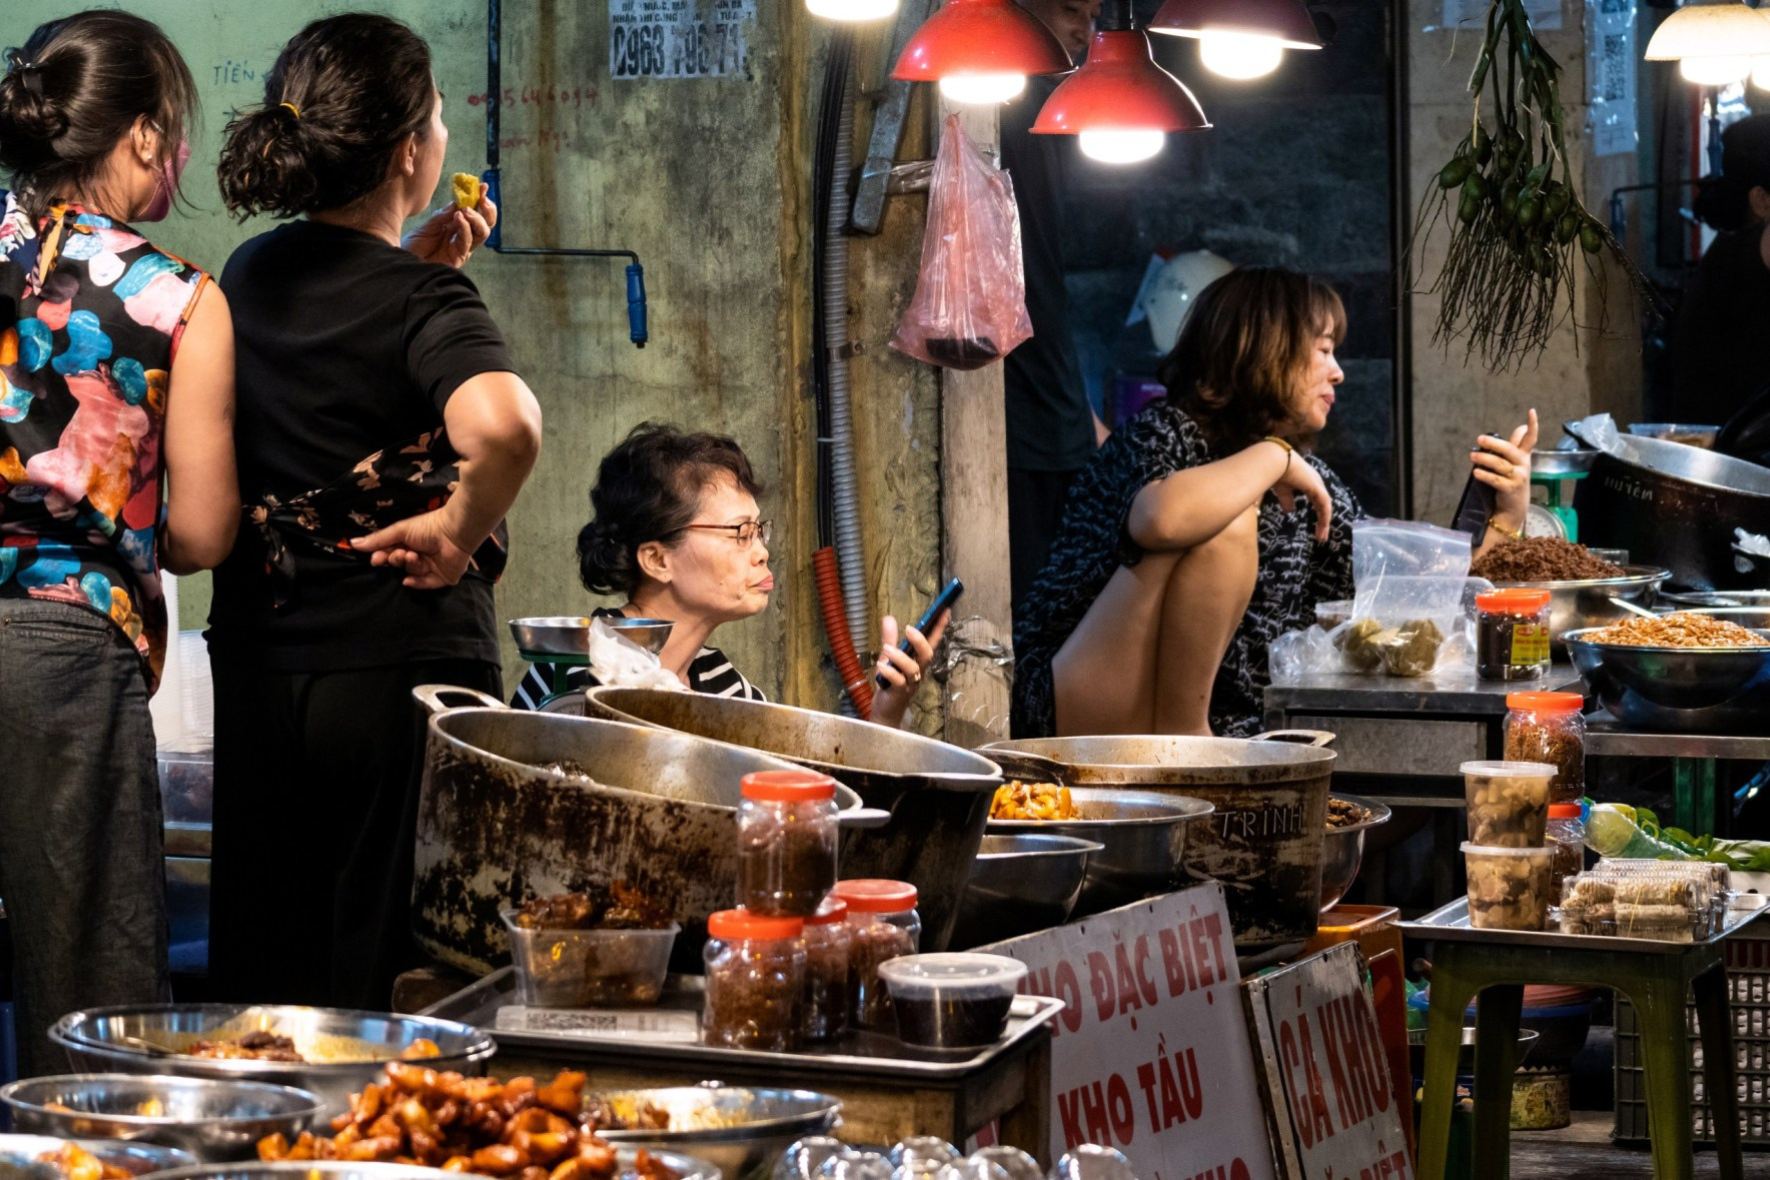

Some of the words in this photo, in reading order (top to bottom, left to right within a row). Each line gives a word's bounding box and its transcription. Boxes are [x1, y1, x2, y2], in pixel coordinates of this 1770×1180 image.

[1087, 930, 1158, 1031] ĐẶC
[1158, 905, 1227, 1005] BIỆT
[1057, 1073, 1134, 1150] KHO
[1137, 1033, 1204, 1133] TẦU
[1280, 987, 1334, 1149] CÁ
[1316, 988, 1391, 1130] KHO
